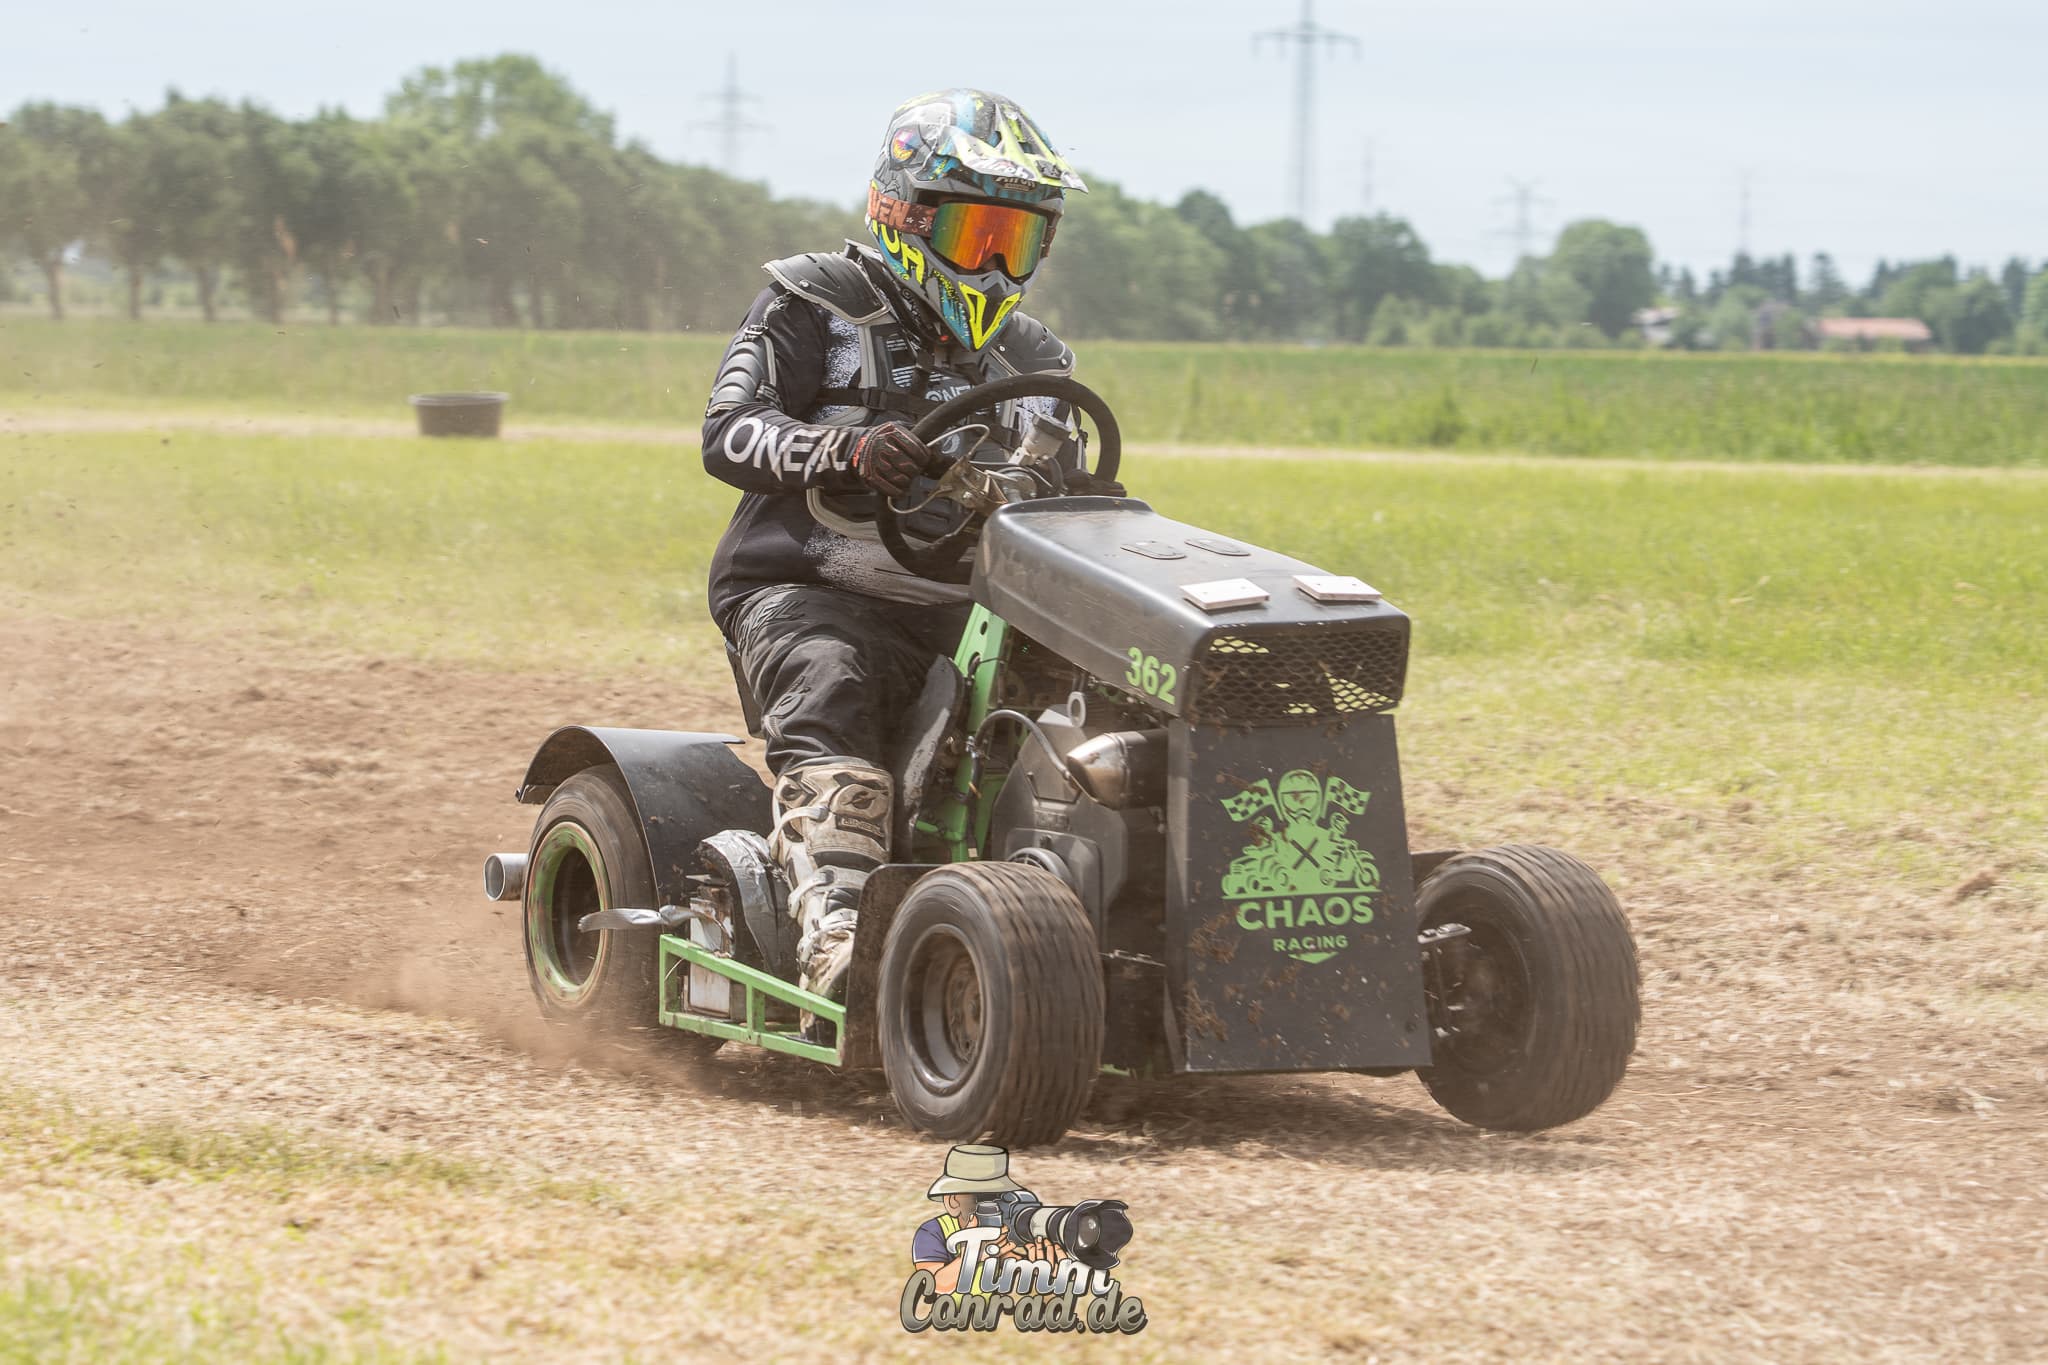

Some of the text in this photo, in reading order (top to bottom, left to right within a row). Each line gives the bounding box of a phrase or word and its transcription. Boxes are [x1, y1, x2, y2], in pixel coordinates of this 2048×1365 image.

[1125, 646, 1177, 705] 362
[1236, 895, 1374, 931] CHAOS
[1273, 934, 1349, 952] RACING
